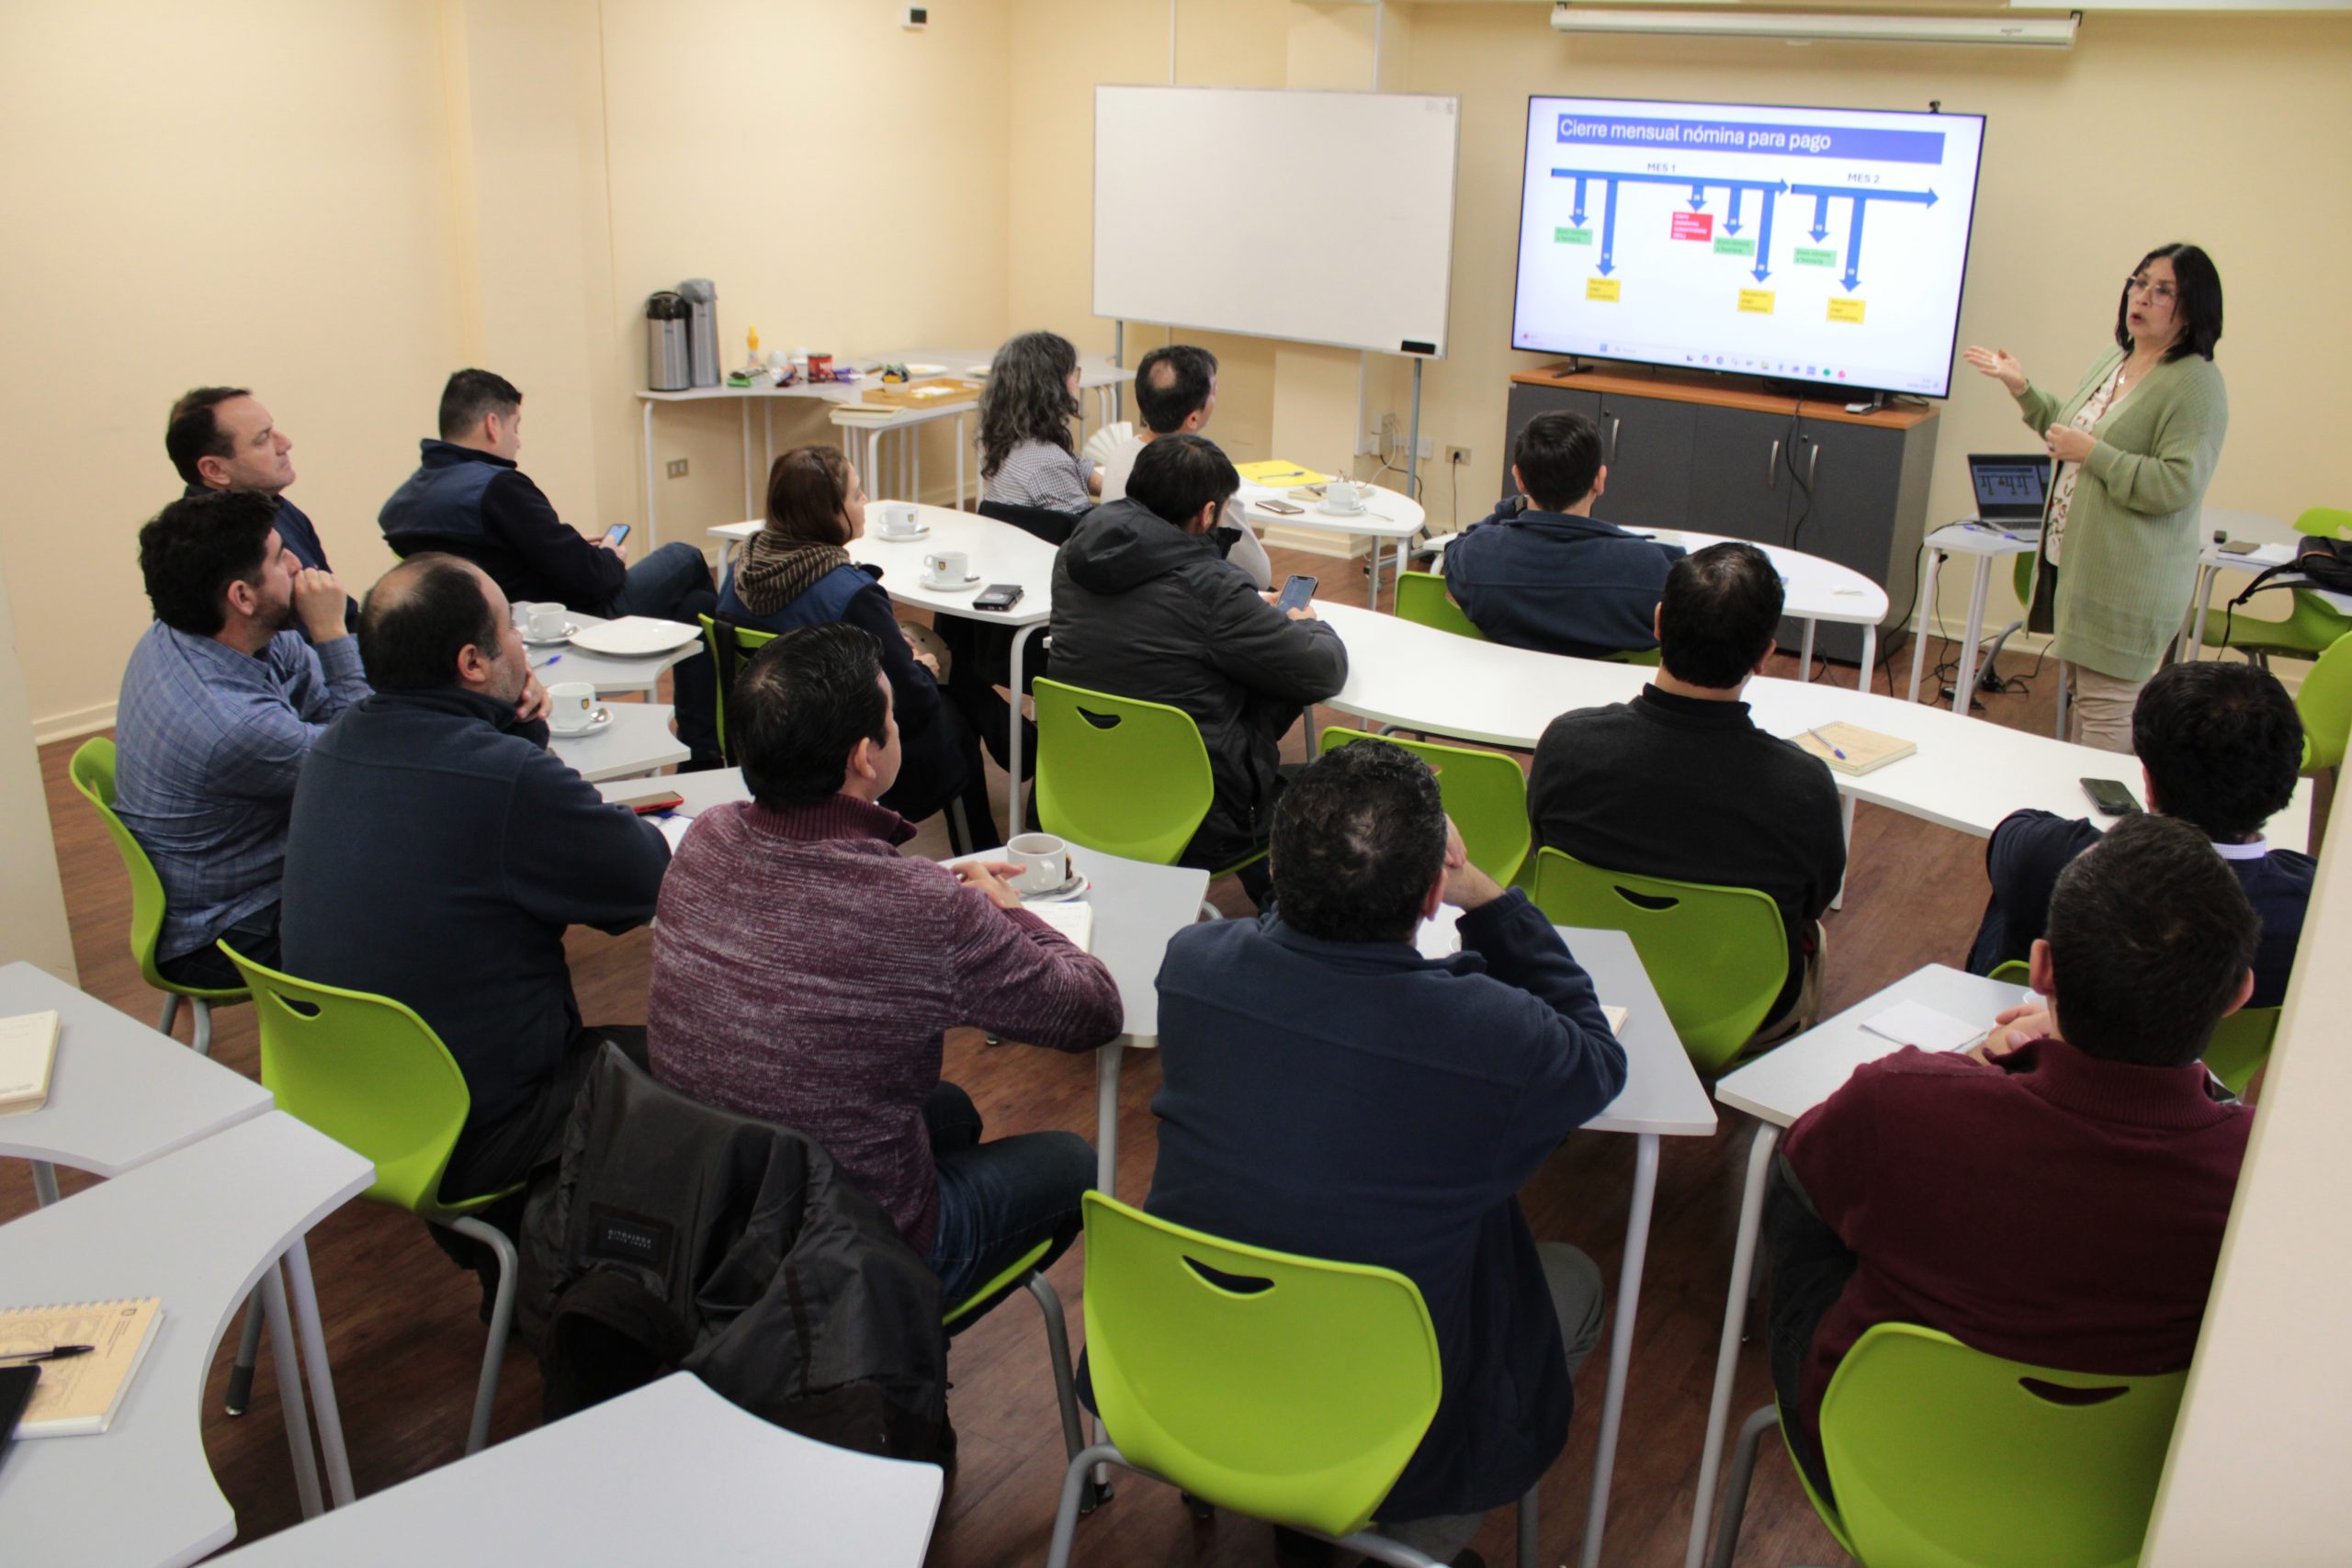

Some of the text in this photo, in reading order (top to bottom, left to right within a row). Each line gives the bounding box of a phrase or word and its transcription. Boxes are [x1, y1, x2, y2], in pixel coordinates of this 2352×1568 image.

[1560, 118, 1831, 153] Cierre mensual nómina para pago
[1646, 163, 1668, 172] MES
[1847, 173, 1880, 184] MES 2
